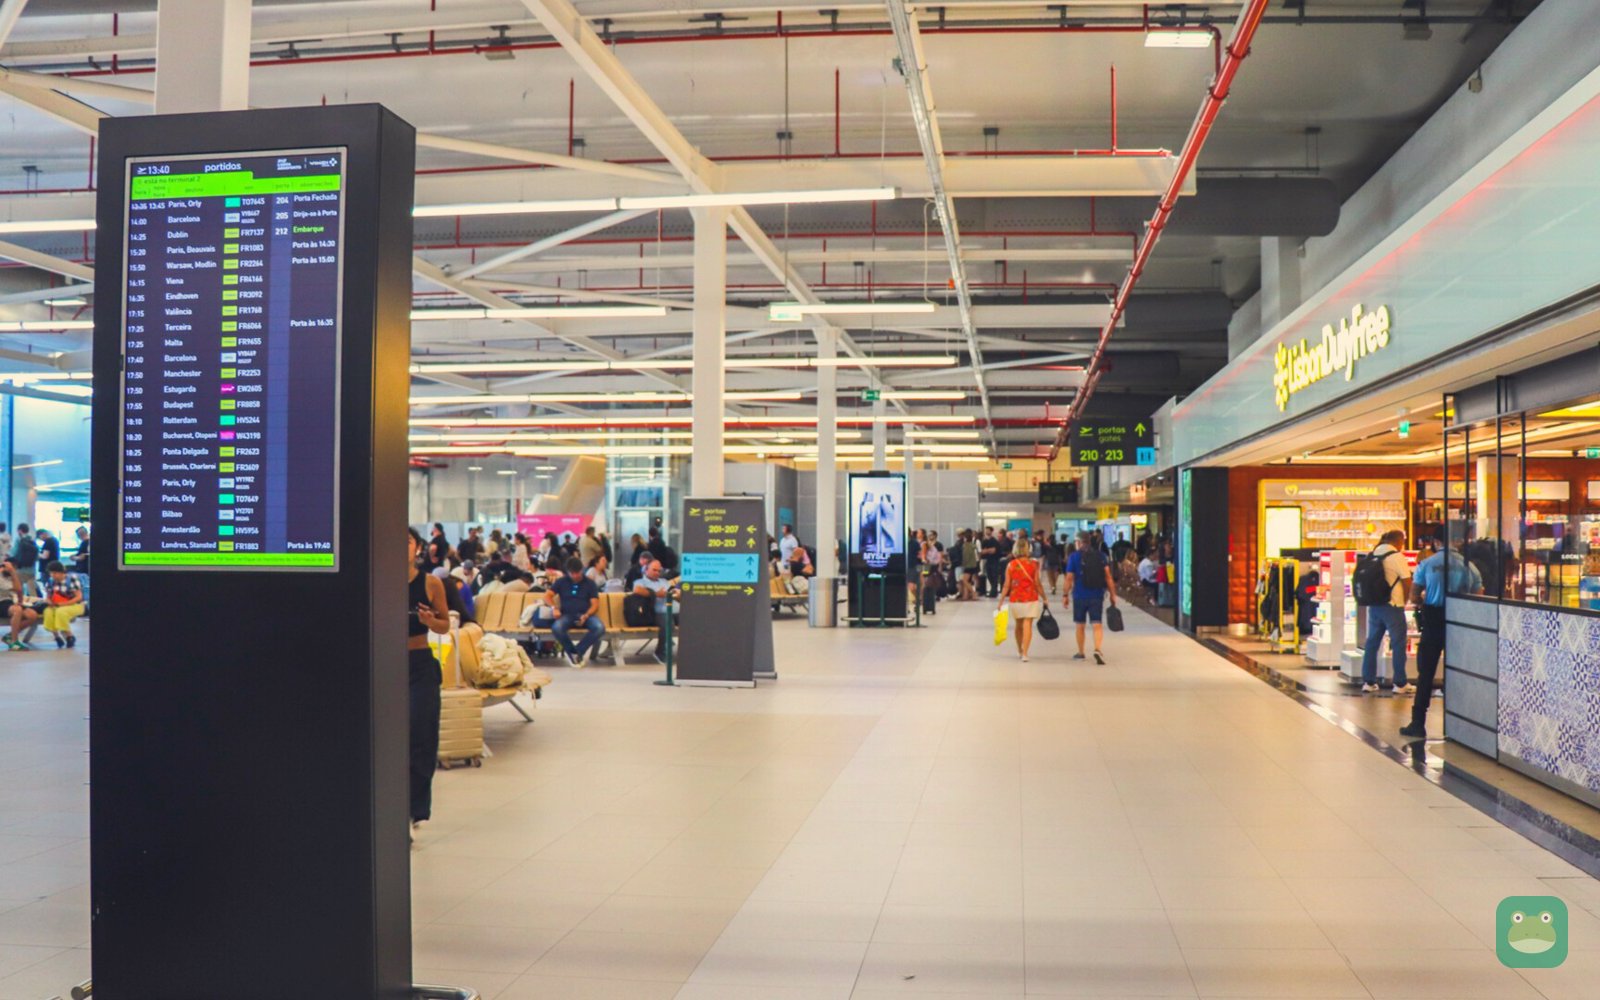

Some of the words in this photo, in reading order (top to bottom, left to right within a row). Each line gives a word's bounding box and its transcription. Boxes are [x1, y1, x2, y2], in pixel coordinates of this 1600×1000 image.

[148, 166, 170, 174] 13:40
[205, 162, 241, 172] partidas
[188, 200, 202, 209] Orly
[276, 197, 288, 205] 204
[168, 215, 200, 223] Barcelona
[276, 212, 288, 220] 205
[168, 231, 188, 239] Dublin
[293, 225, 324, 233] Embarque
[166, 277, 184, 285] Viena
[166, 292, 198, 300] Eindhoven
[165, 307, 192, 316] Valência
[1287, 303, 1391, 393] LisbonDutyFree
[164, 354, 197, 362] Barcelona
[164, 385, 196, 394] Estugarda
[164, 401, 194, 409] Budapest
[163, 431, 194, 439] Bucharest,
[195, 431, 217, 439] Otopeni
[1098, 426, 1126, 435] portas
[1099, 435, 1121, 443] gates
[183, 448, 209, 456] Delgada
[1080, 450, 1098, 462] 210
[1105, 450, 1124, 461] 213
[162, 463, 189, 471] Brussels,
[162, 479, 181, 487] Paris,
[183, 479, 196, 488] Orly
[1332, 486, 1379, 496] PORTUGAL
[162, 495, 181, 503] Paris,
[183, 495, 196, 504] Orly
[704, 508, 727, 517] portas
[162, 526, 200, 534] Amesterdão
[708, 525, 739, 534] 201-207
[124, 542, 141, 550] 21:00
[162, 542, 188, 550] Londres,
